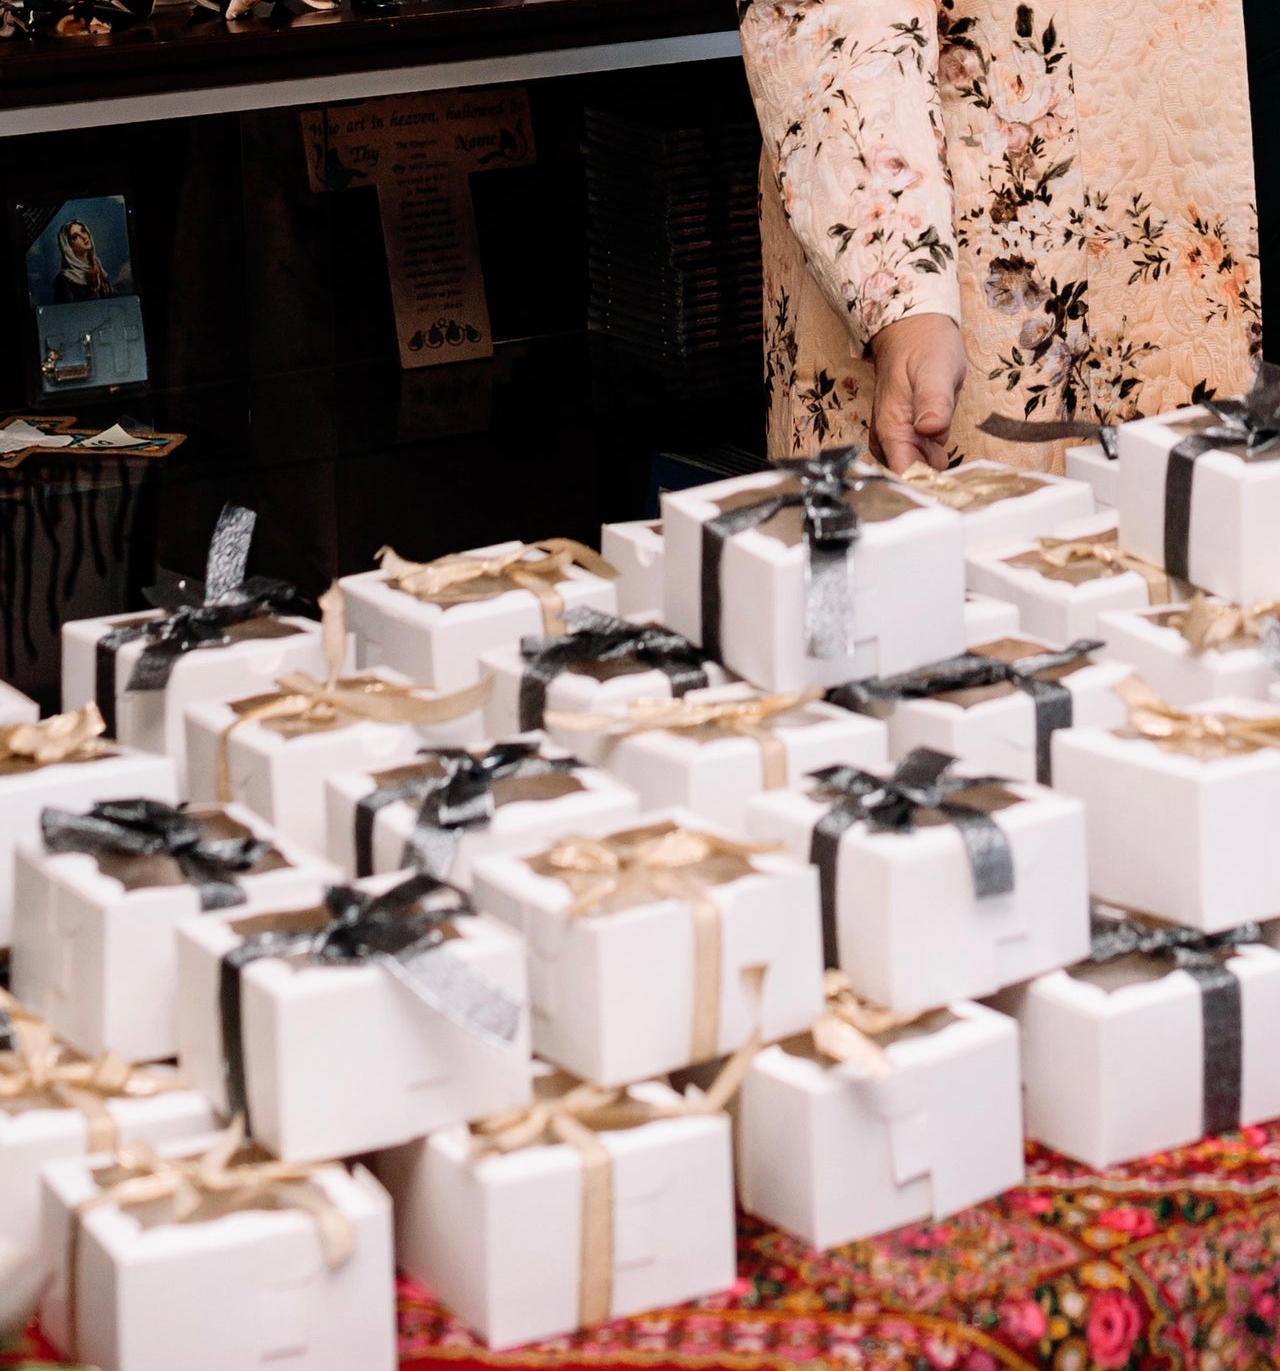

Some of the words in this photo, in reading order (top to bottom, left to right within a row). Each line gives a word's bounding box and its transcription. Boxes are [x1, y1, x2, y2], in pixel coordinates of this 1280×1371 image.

[308, 118, 340, 137] Who
[346, 117, 366, 133] art
[371, 114, 385, 130] in
[390, 110, 439, 128] heaven,
[446, 101, 505, 121] hallowed
[351, 145, 380, 166] Thy
[455, 132, 497, 152] Name
